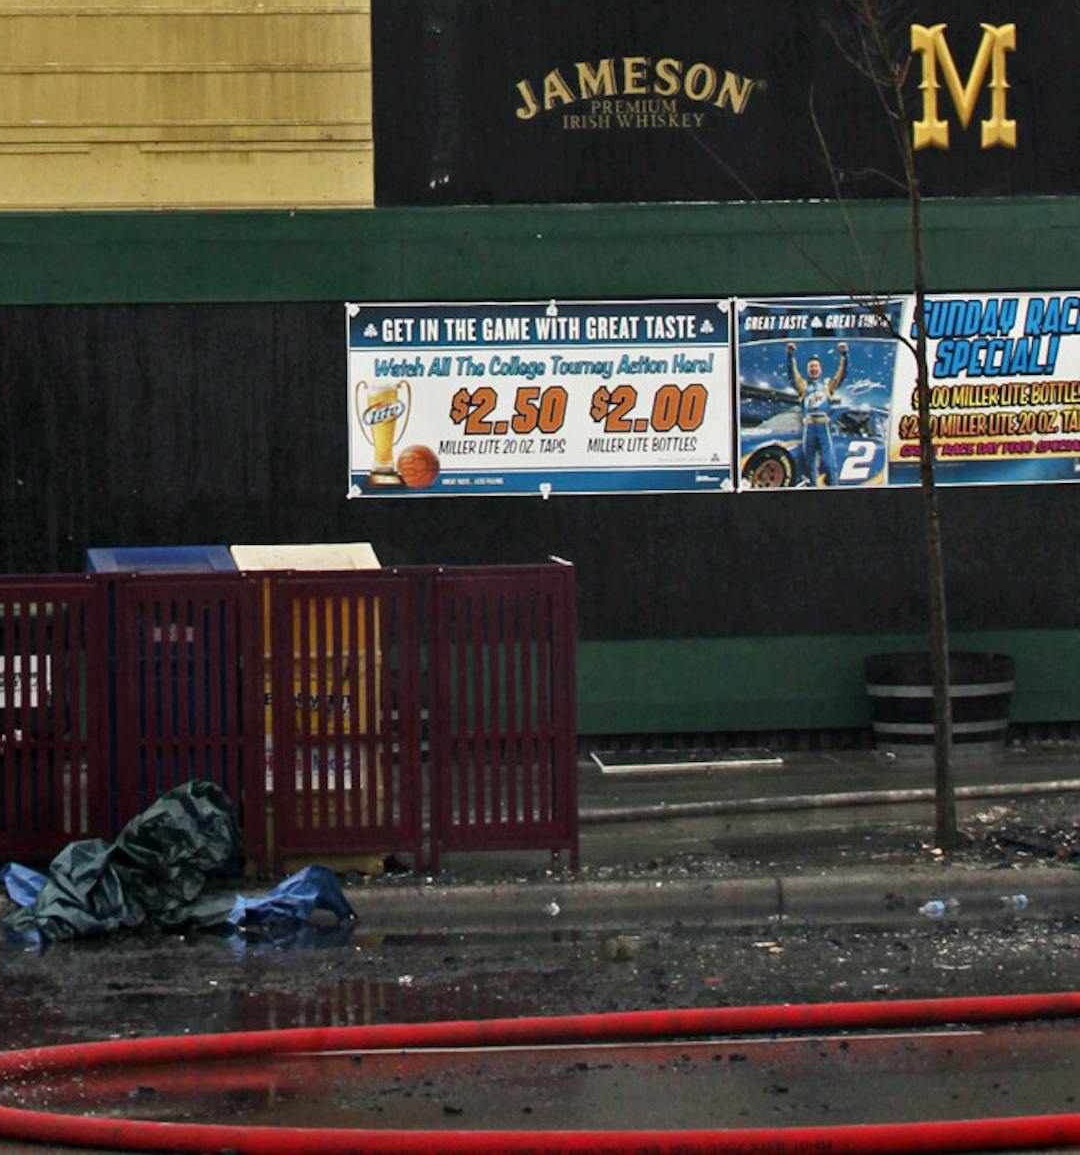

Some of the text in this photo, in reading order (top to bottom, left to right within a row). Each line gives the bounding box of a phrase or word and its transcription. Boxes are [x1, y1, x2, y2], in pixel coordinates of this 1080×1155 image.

[516, 57, 754, 120] JAMESON
[910, 23, 1017, 149] M
[591, 99, 678, 114] PREMIUM
[563, 113, 705, 130] IRISH WHISKEY
[382, 315, 697, 341] GET IN THE GAME WITH GREAT TASTE
[744, 316, 776, 331] GREAT
[778, 315, 809, 329] TASTE
[825, 315, 856, 329] GREAT
[374, 357, 425, 378] Watch
[428, 357, 452, 377] All
[456, 356, 486, 377] The
[489, 354, 545, 380] College
[551, 355, 613, 380] Tourney
[616, 354, 668, 375] Action
[933, 336, 1061, 379] SPECIAL!
[911, 385, 950, 410] $.00
[951, 383, 999, 408] MILLER
[1000, 382, 1029, 406] LITE
[449, 384, 709, 436] $2.50 $2.00
[899, 413, 938, 440] $2.0
[940, 412, 988, 437] MILLER
[989, 411, 1018, 435] LITE
[1019, 410, 1037, 434] 20
[1060, 409, 1080, 434] TA
[439, 438, 566, 456] MILLER LITE 20 OZ. TAPS
[587, 436, 698, 453] MILLER LITE BOTTLES
[839, 440, 877, 481] 2
